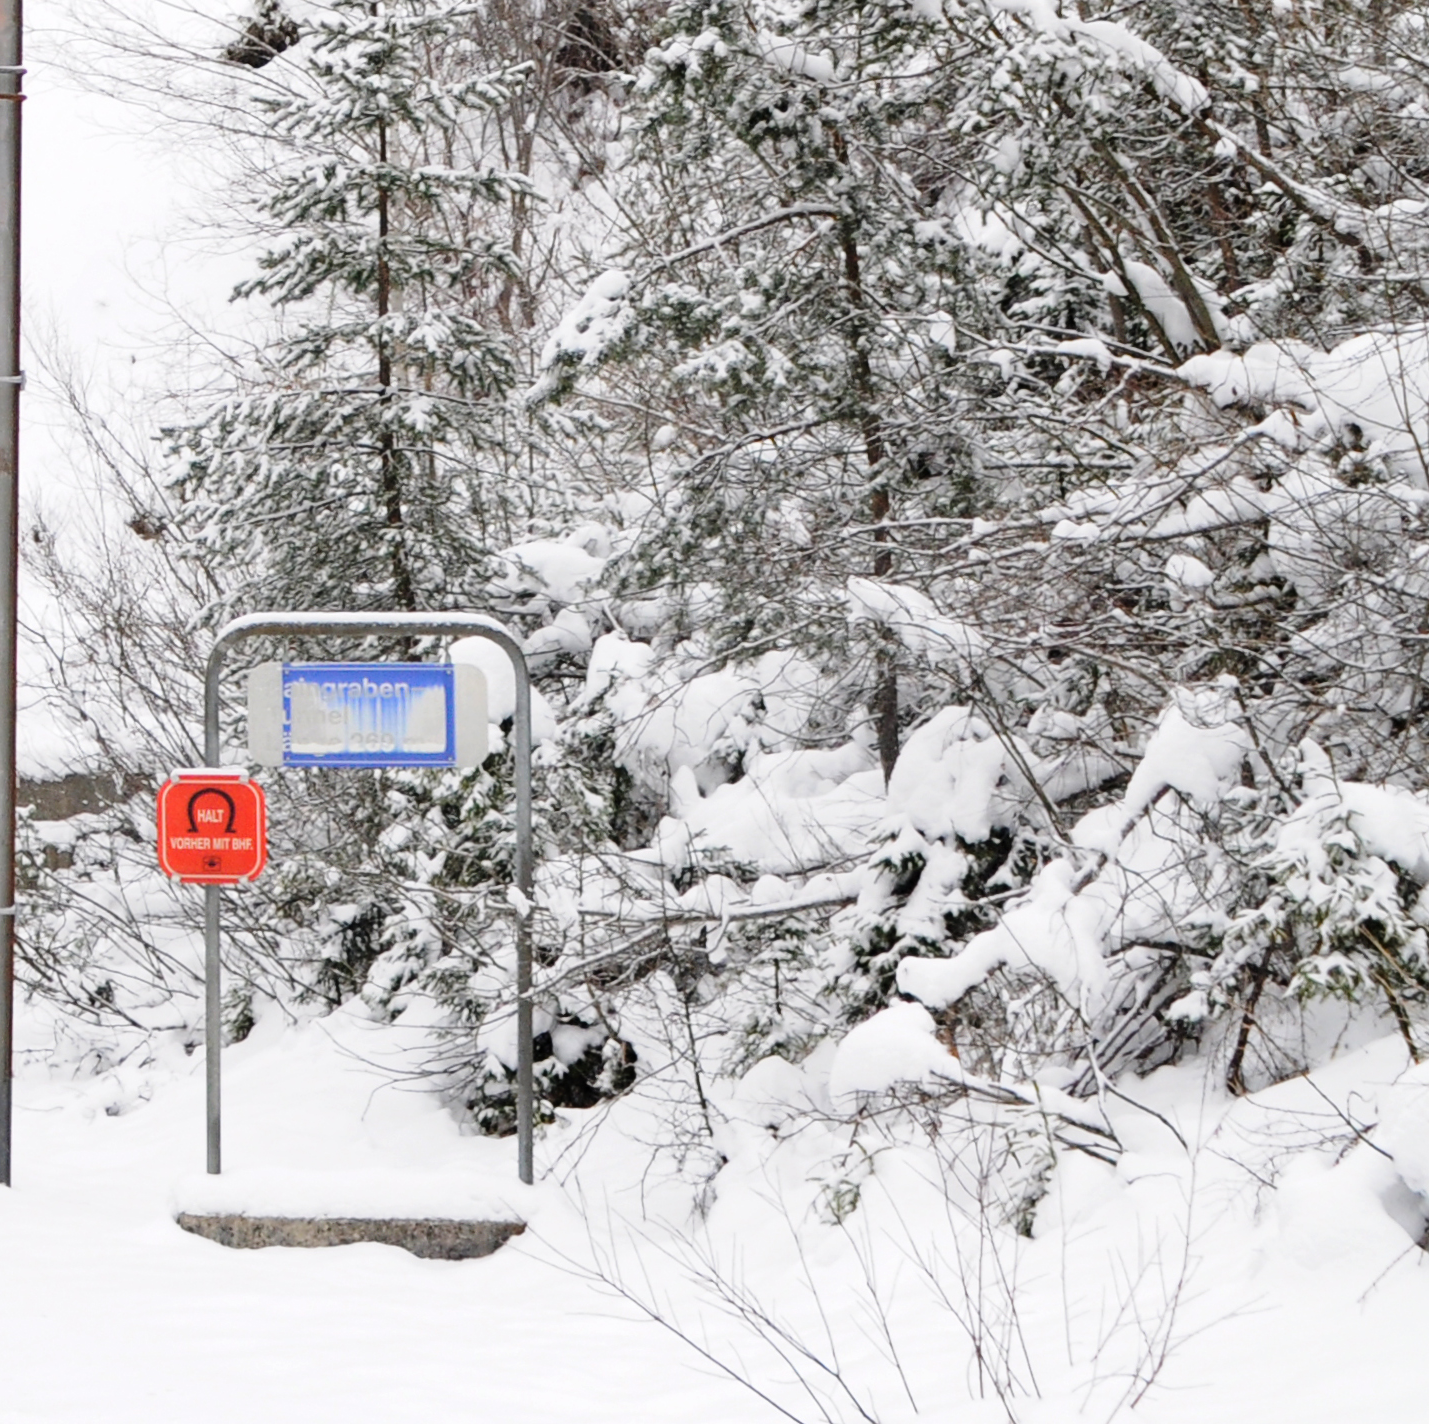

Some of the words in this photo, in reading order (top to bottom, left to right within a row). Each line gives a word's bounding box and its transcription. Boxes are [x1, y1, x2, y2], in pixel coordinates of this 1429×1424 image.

[197, 809, 224, 823] HALT
[170, 837, 211, 850] VORHER
[212, 837, 231, 850] MIT
[232, 837, 254, 851] BHF.
